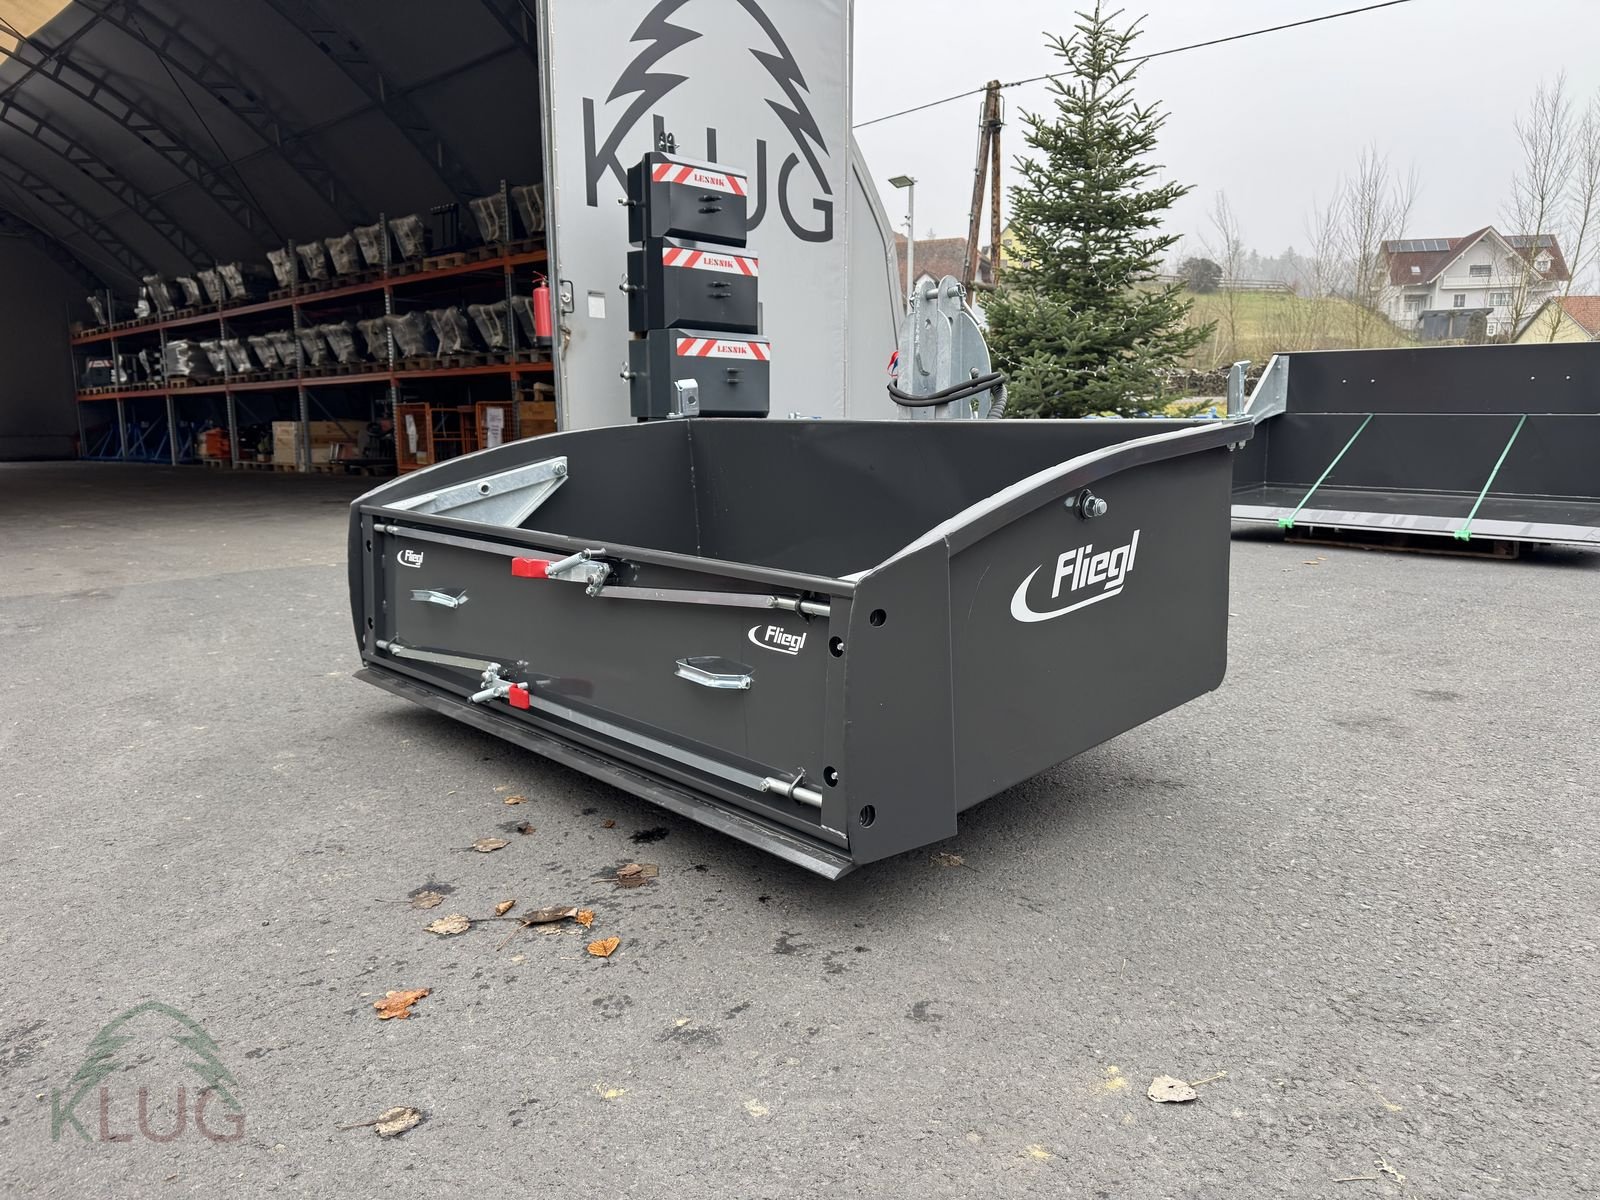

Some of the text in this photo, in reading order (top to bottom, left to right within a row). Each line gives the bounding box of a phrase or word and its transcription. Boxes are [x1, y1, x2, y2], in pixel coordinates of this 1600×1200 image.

[694, 173, 726, 187] LESNIK
[703, 257, 734, 269] LESNIK
[717, 345, 747, 355] LESNIK
[1051, 529, 1140, 599] Fliegl
[764, 625, 807, 652] Fliegl
